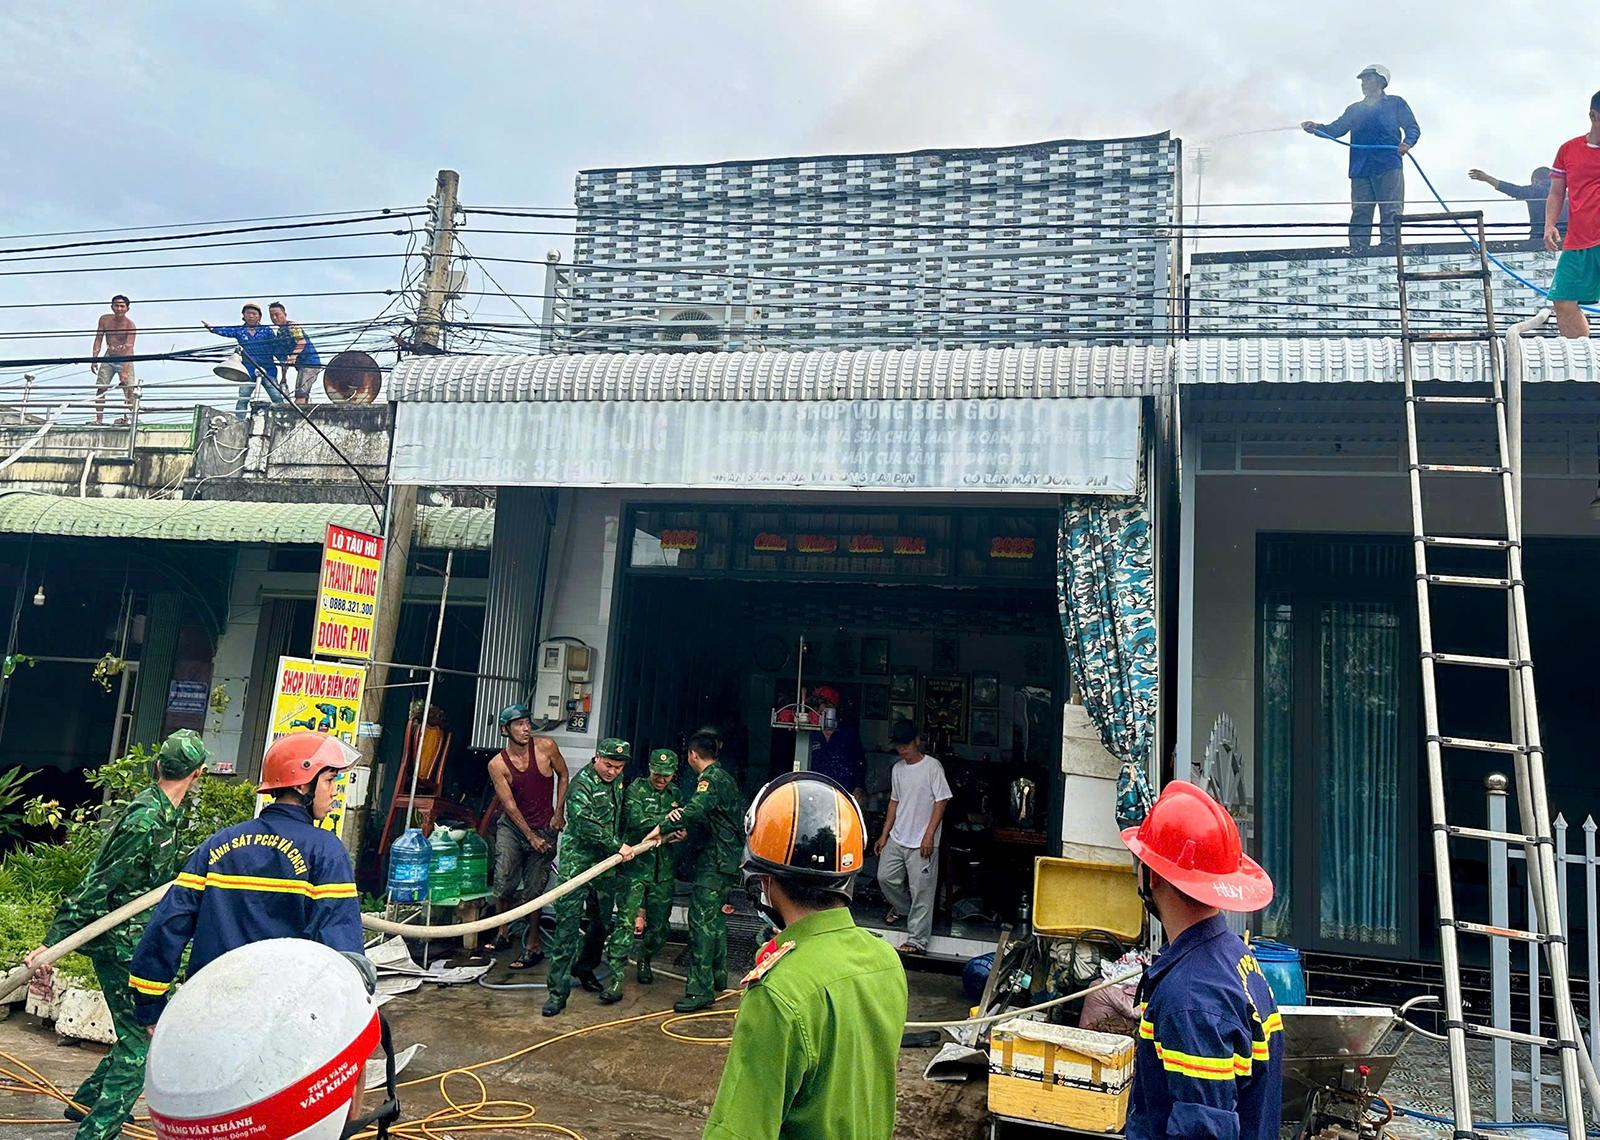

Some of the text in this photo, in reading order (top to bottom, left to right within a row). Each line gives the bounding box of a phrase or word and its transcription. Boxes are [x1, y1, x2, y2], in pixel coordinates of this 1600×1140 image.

[893, 473, 916, 484] PIN
[332, 531, 377, 557] LÒ TÀU HỦ
[353, 566, 378, 597] LONG
[329, 597, 373, 616] 0888.321.300
[350, 626, 370, 652] PIN
[281, 670, 304, 694] SHOP
[571, 716, 584, 727] 36
[231, 834, 253, 849] SÁT
[254, 833, 280, 847] PCCC
[277, 838, 294, 854] VÀ
[287, 847, 308, 876] CNCH
[326, 1062, 359, 1094] KHÁNH
[211, 1116, 254, 1134] KHÁNH
[249, 1124, 267, 1135] Tháp
